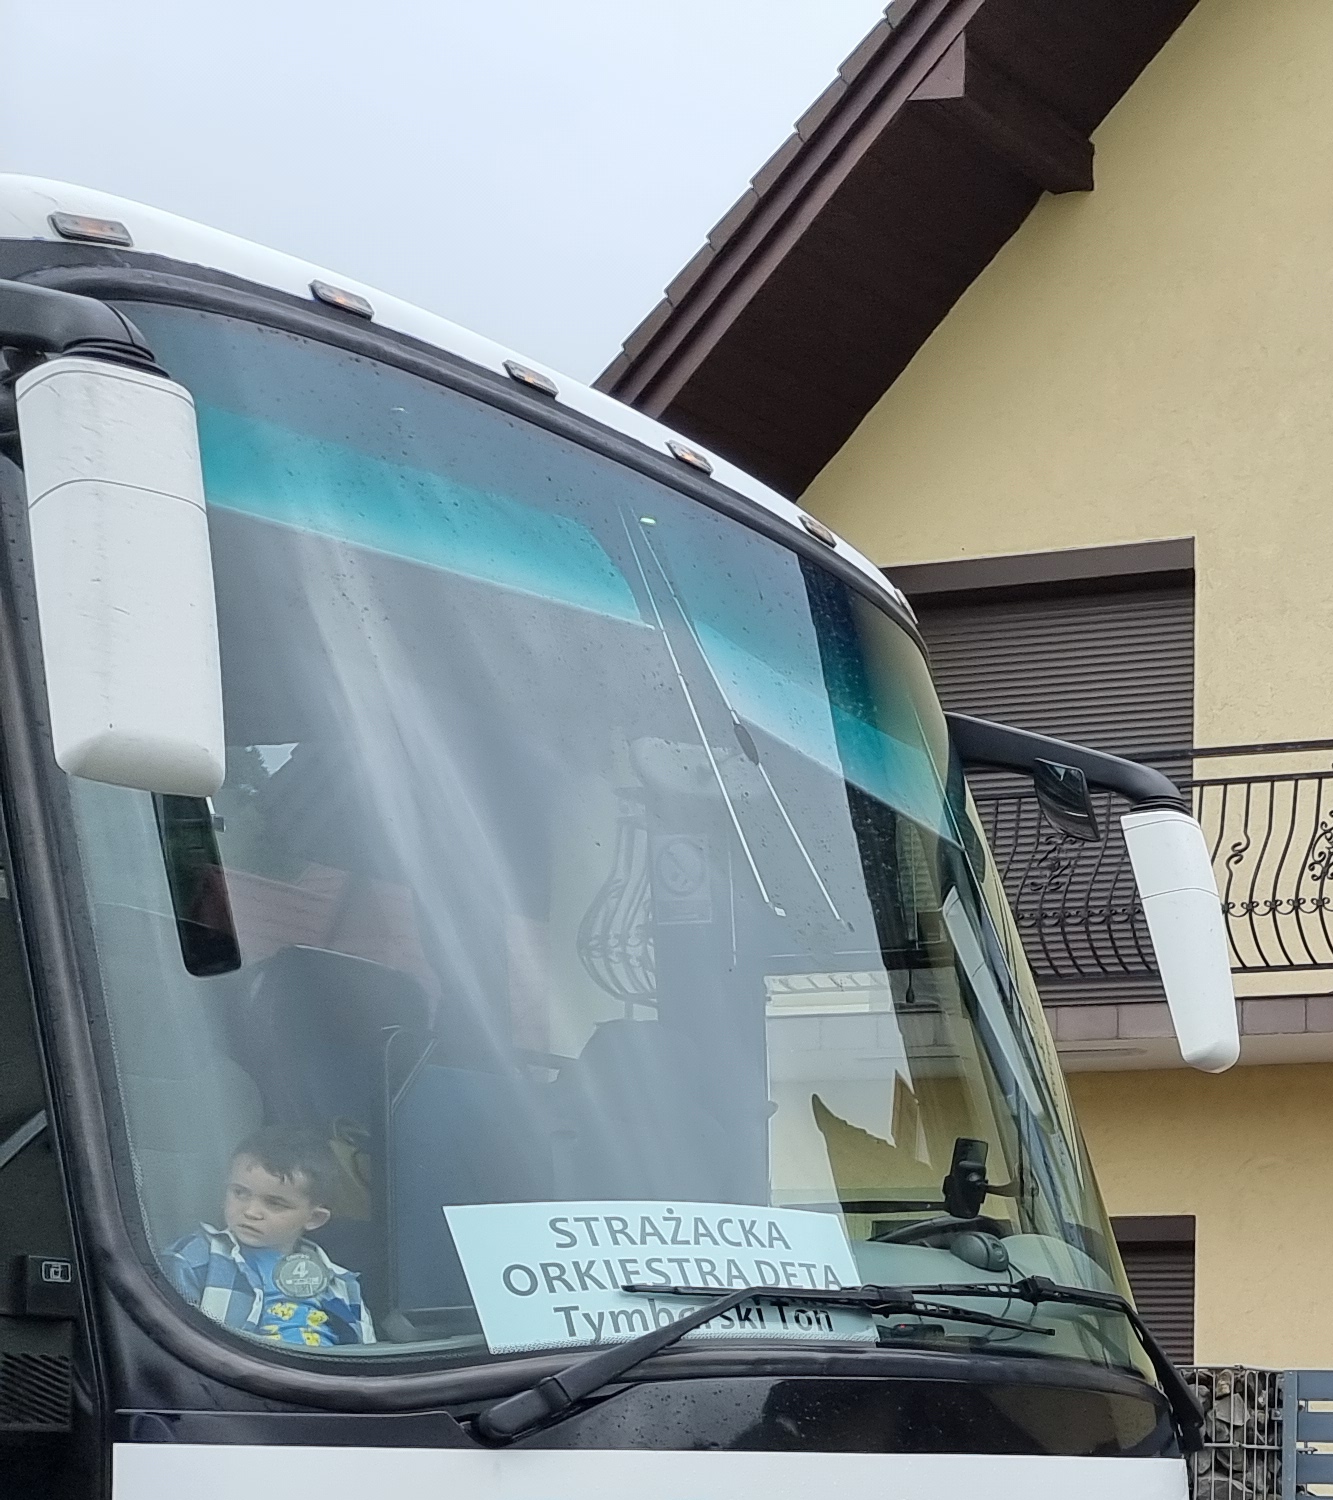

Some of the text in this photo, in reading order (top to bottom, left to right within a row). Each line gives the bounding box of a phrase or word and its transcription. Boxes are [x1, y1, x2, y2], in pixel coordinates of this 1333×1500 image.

[548, 1207, 792, 1251] STRAŻACKA
[502, 1257, 751, 1297] ORKIESTRA
[552, 1298, 767, 1343] Tymbski
